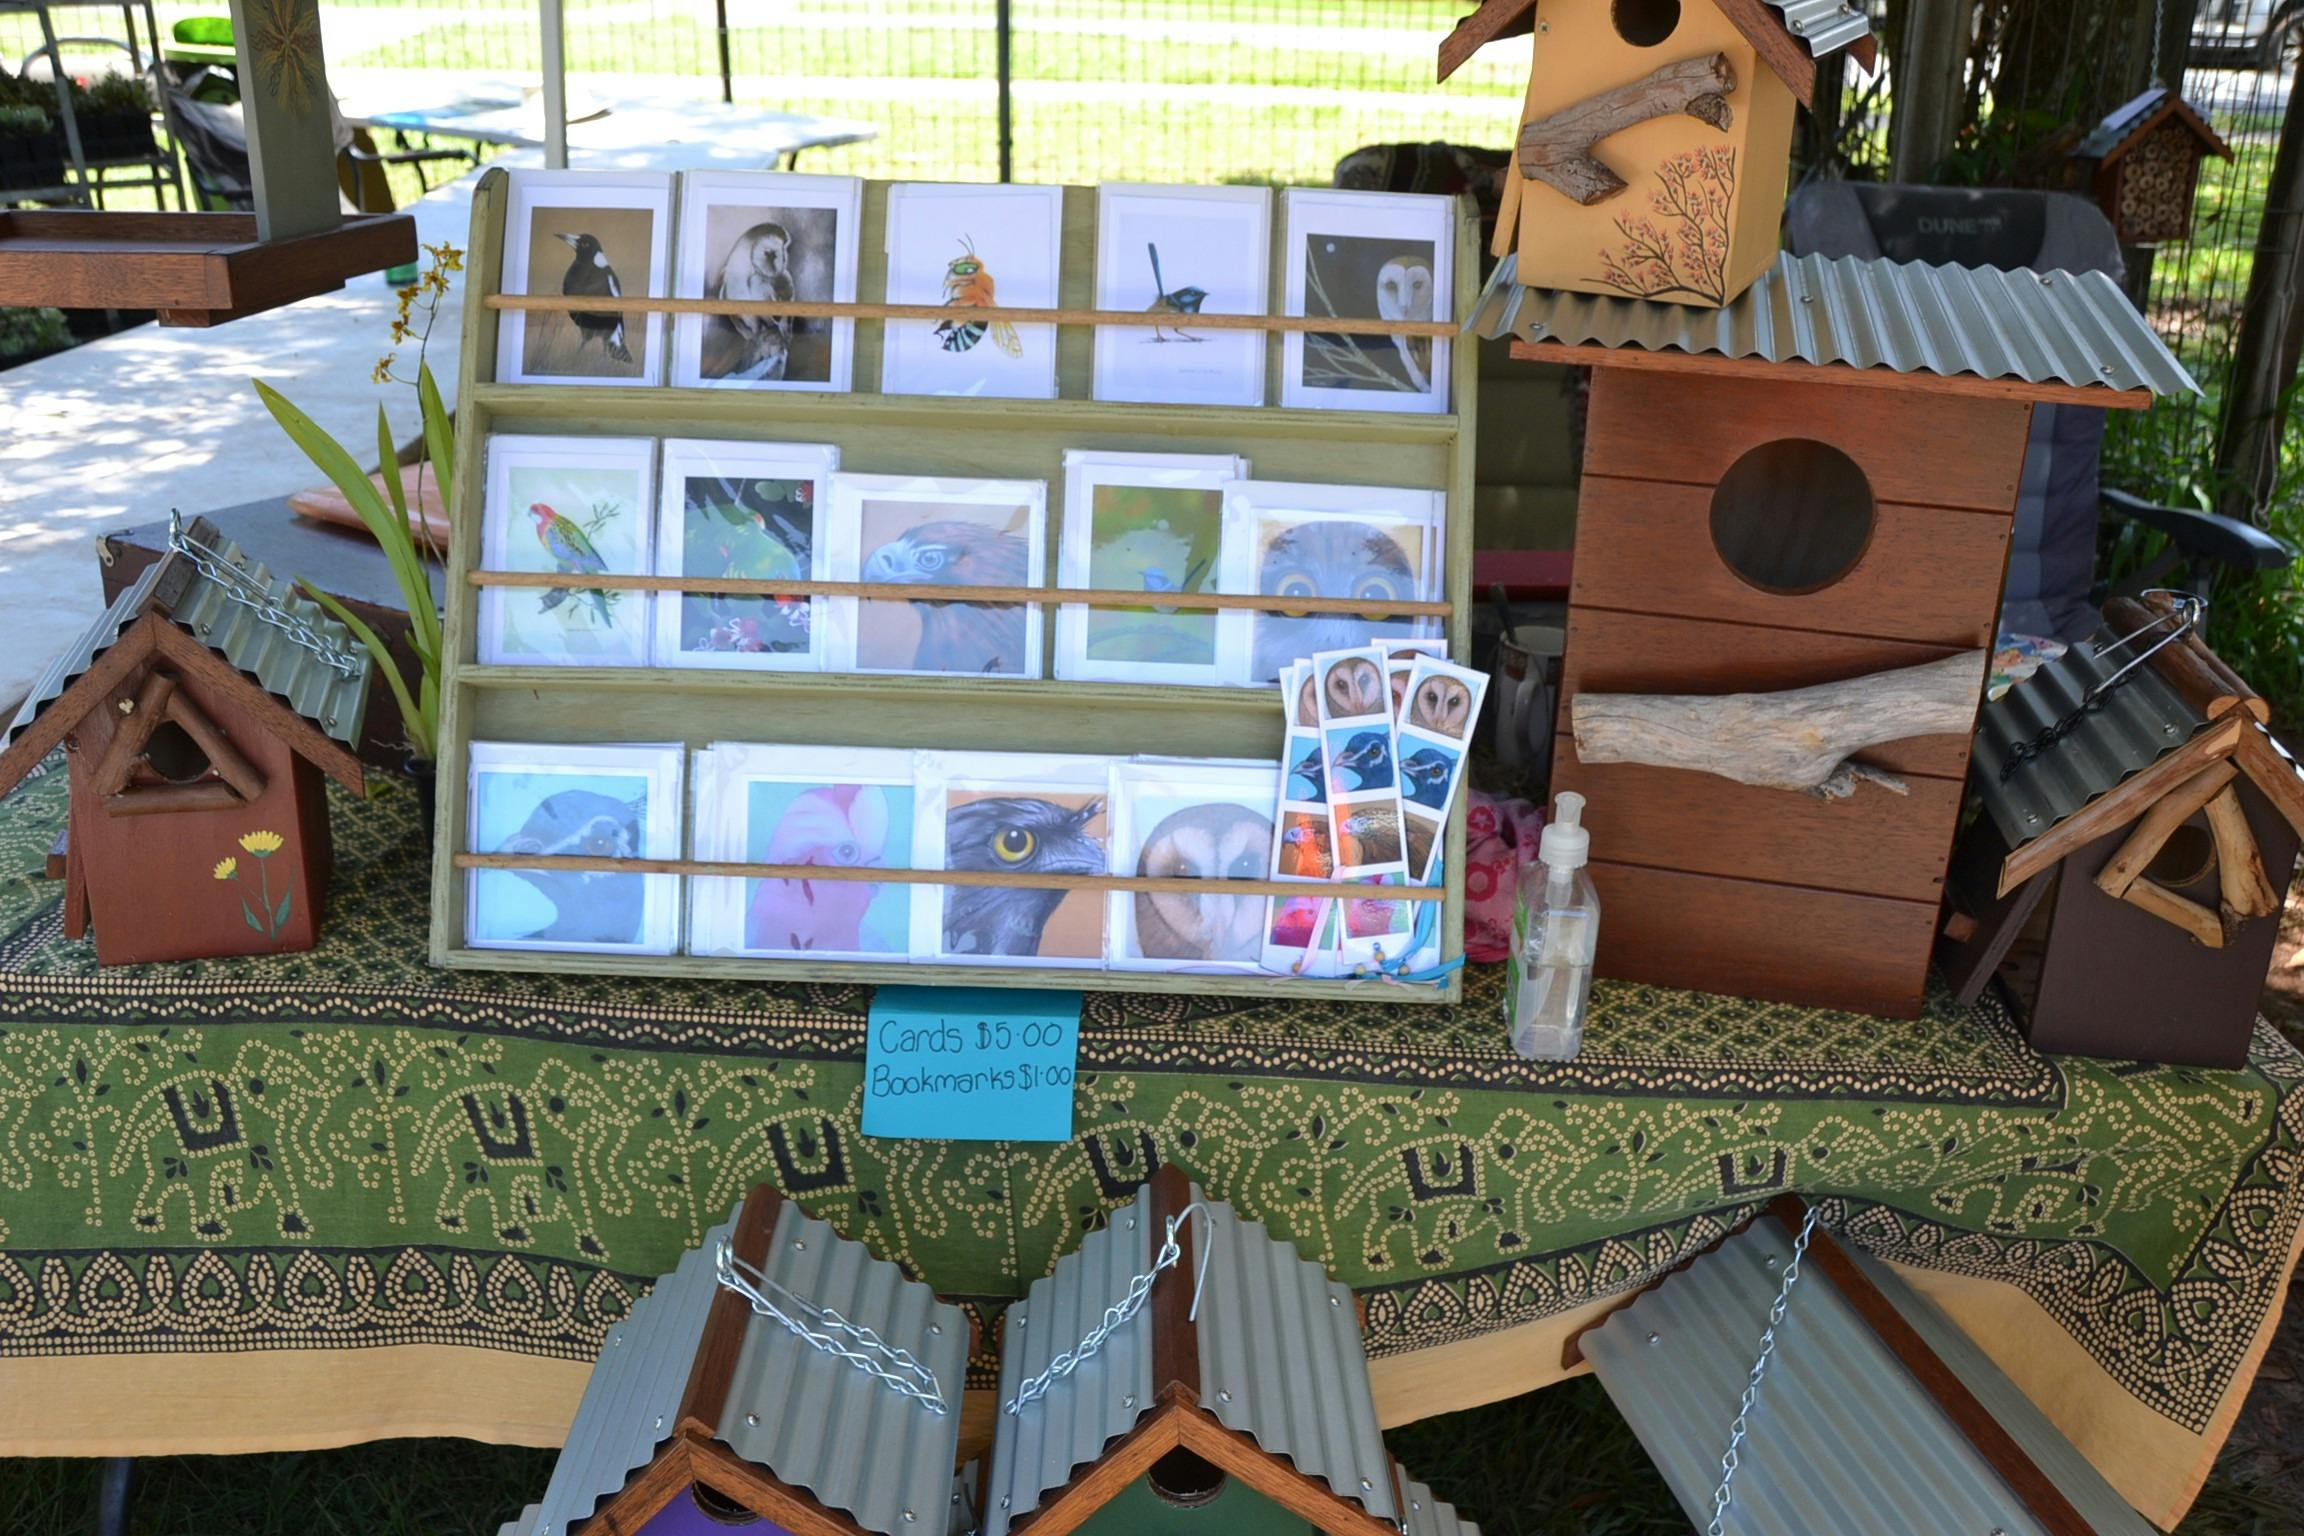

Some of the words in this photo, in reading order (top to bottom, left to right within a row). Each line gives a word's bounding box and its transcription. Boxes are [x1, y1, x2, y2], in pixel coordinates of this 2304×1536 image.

[1917, 216, 1976, 235] DUNE
[879, 1019, 963, 1053] Cards
[872, 1064, 1015, 1097] Bookmarks
